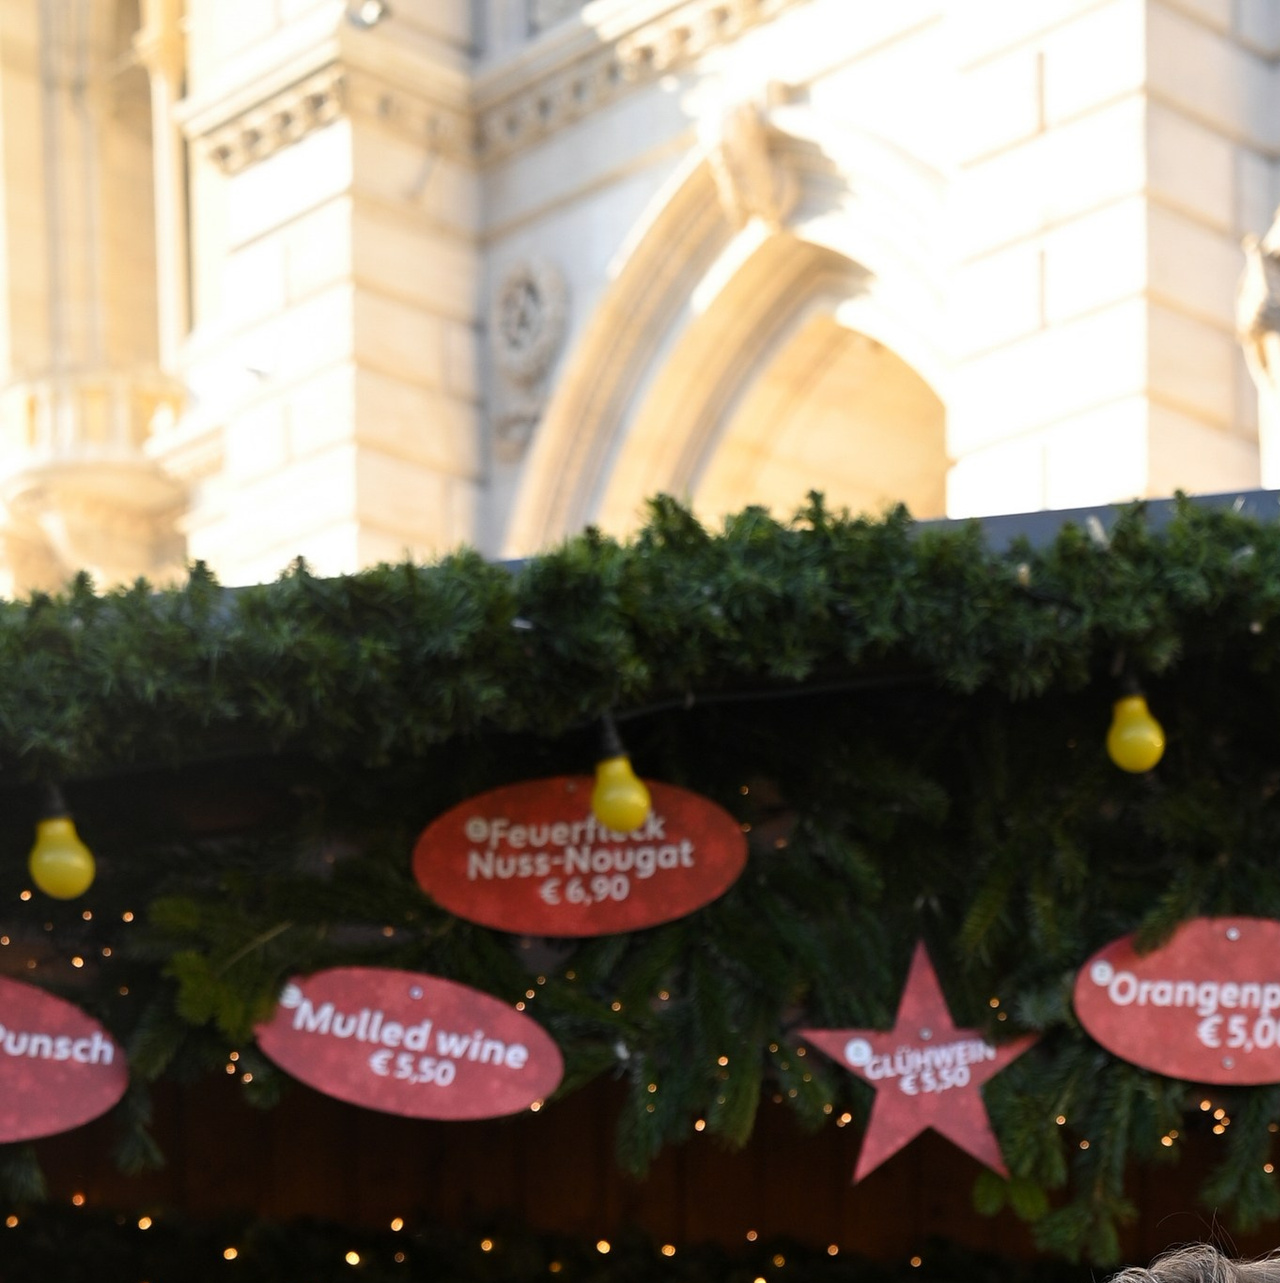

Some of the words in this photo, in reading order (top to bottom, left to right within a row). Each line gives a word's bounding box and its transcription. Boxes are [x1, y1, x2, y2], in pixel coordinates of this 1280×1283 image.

[466, 838, 696, 881] Nuss-Nougat
[540, 877, 562, 906] €
[565, 874, 631, 907] 6,90
[292, 998, 433, 1052] Mulled
[435, 1028, 529, 1070] wine
[1197, 1013, 1223, 1049] €
[369, 1049, 394, 1077] €
[394, 1051, 457, 1087] 5,50
